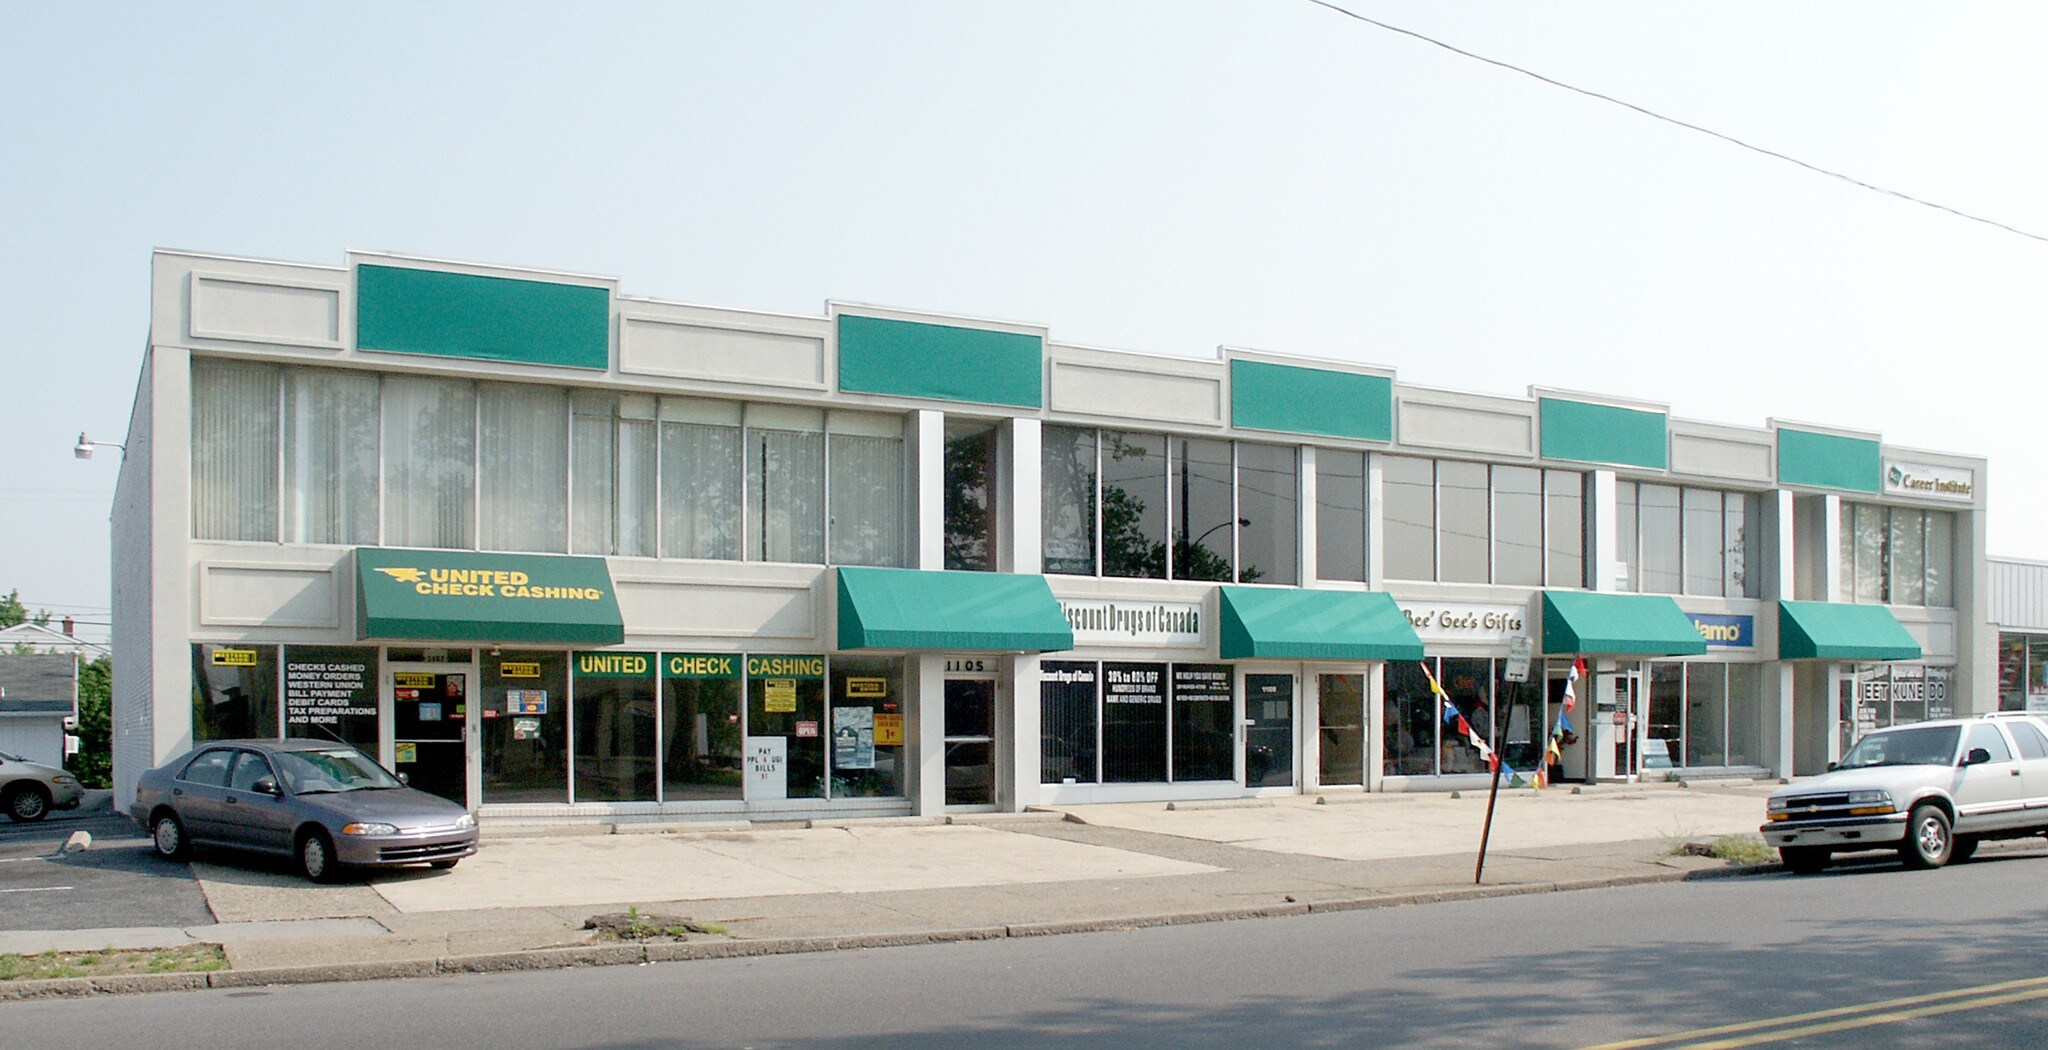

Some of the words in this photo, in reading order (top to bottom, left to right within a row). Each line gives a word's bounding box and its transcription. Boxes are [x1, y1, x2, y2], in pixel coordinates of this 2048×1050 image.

[1903, 474, 1933, 491] Career
[1934, 478, 1972, 495] Institute
[429, 568, 529, 586] UNITED
[415, 581, 495, 597] CHECK
[500, 585, 600, 601] CASHING
[1058, 602, 1107, 631] iscount
[1109, 603, 1143, 637] Drugs
[1146, 605, 1156, 633] of
[1159, 605, 1199, 634] Canada
[1440, 610, 1478, 629] Gee's
[1483, 612, 1522, 633] Gifts
[1695, 619, 1740, 641] lamo
[288, 663, 326, 671] CHECKS
[327, 664, 365, 672] CASHED
[580, 656, 647, 674] UNITED
[670, 657, 732, 675] CHECK
[748, 658, 824, 676] CASHING
[946, 660, 984, 671] 1105
[288, 672, 321, 680] MONEY
[322, 672, 361, 680] ORDERS
[1146, 671, 1159, 683] OFF
[288, 681, 333, 689] WESTERN
[334, 681, 364, 689] UNION
[310, 690, 353, 698] PAYMENT
[1858, 682, 1889, 706] JEET
[1893, 682, 1923, 701] KUNE
[1929, 682, 1945, 701] DO
[288, 698, 316, 706] DEBIT
[317, 698, 349, 706] CARDS
[289, 707, 306, 715] TAX
[308, 707, 377, 716] PREPARATIONS
[289, 716, 309, 724] AND
[310, 716, 338, 724] MORE
[758, 747, 771, 755] PAY
[755, 764, 776, 772] BILLS
